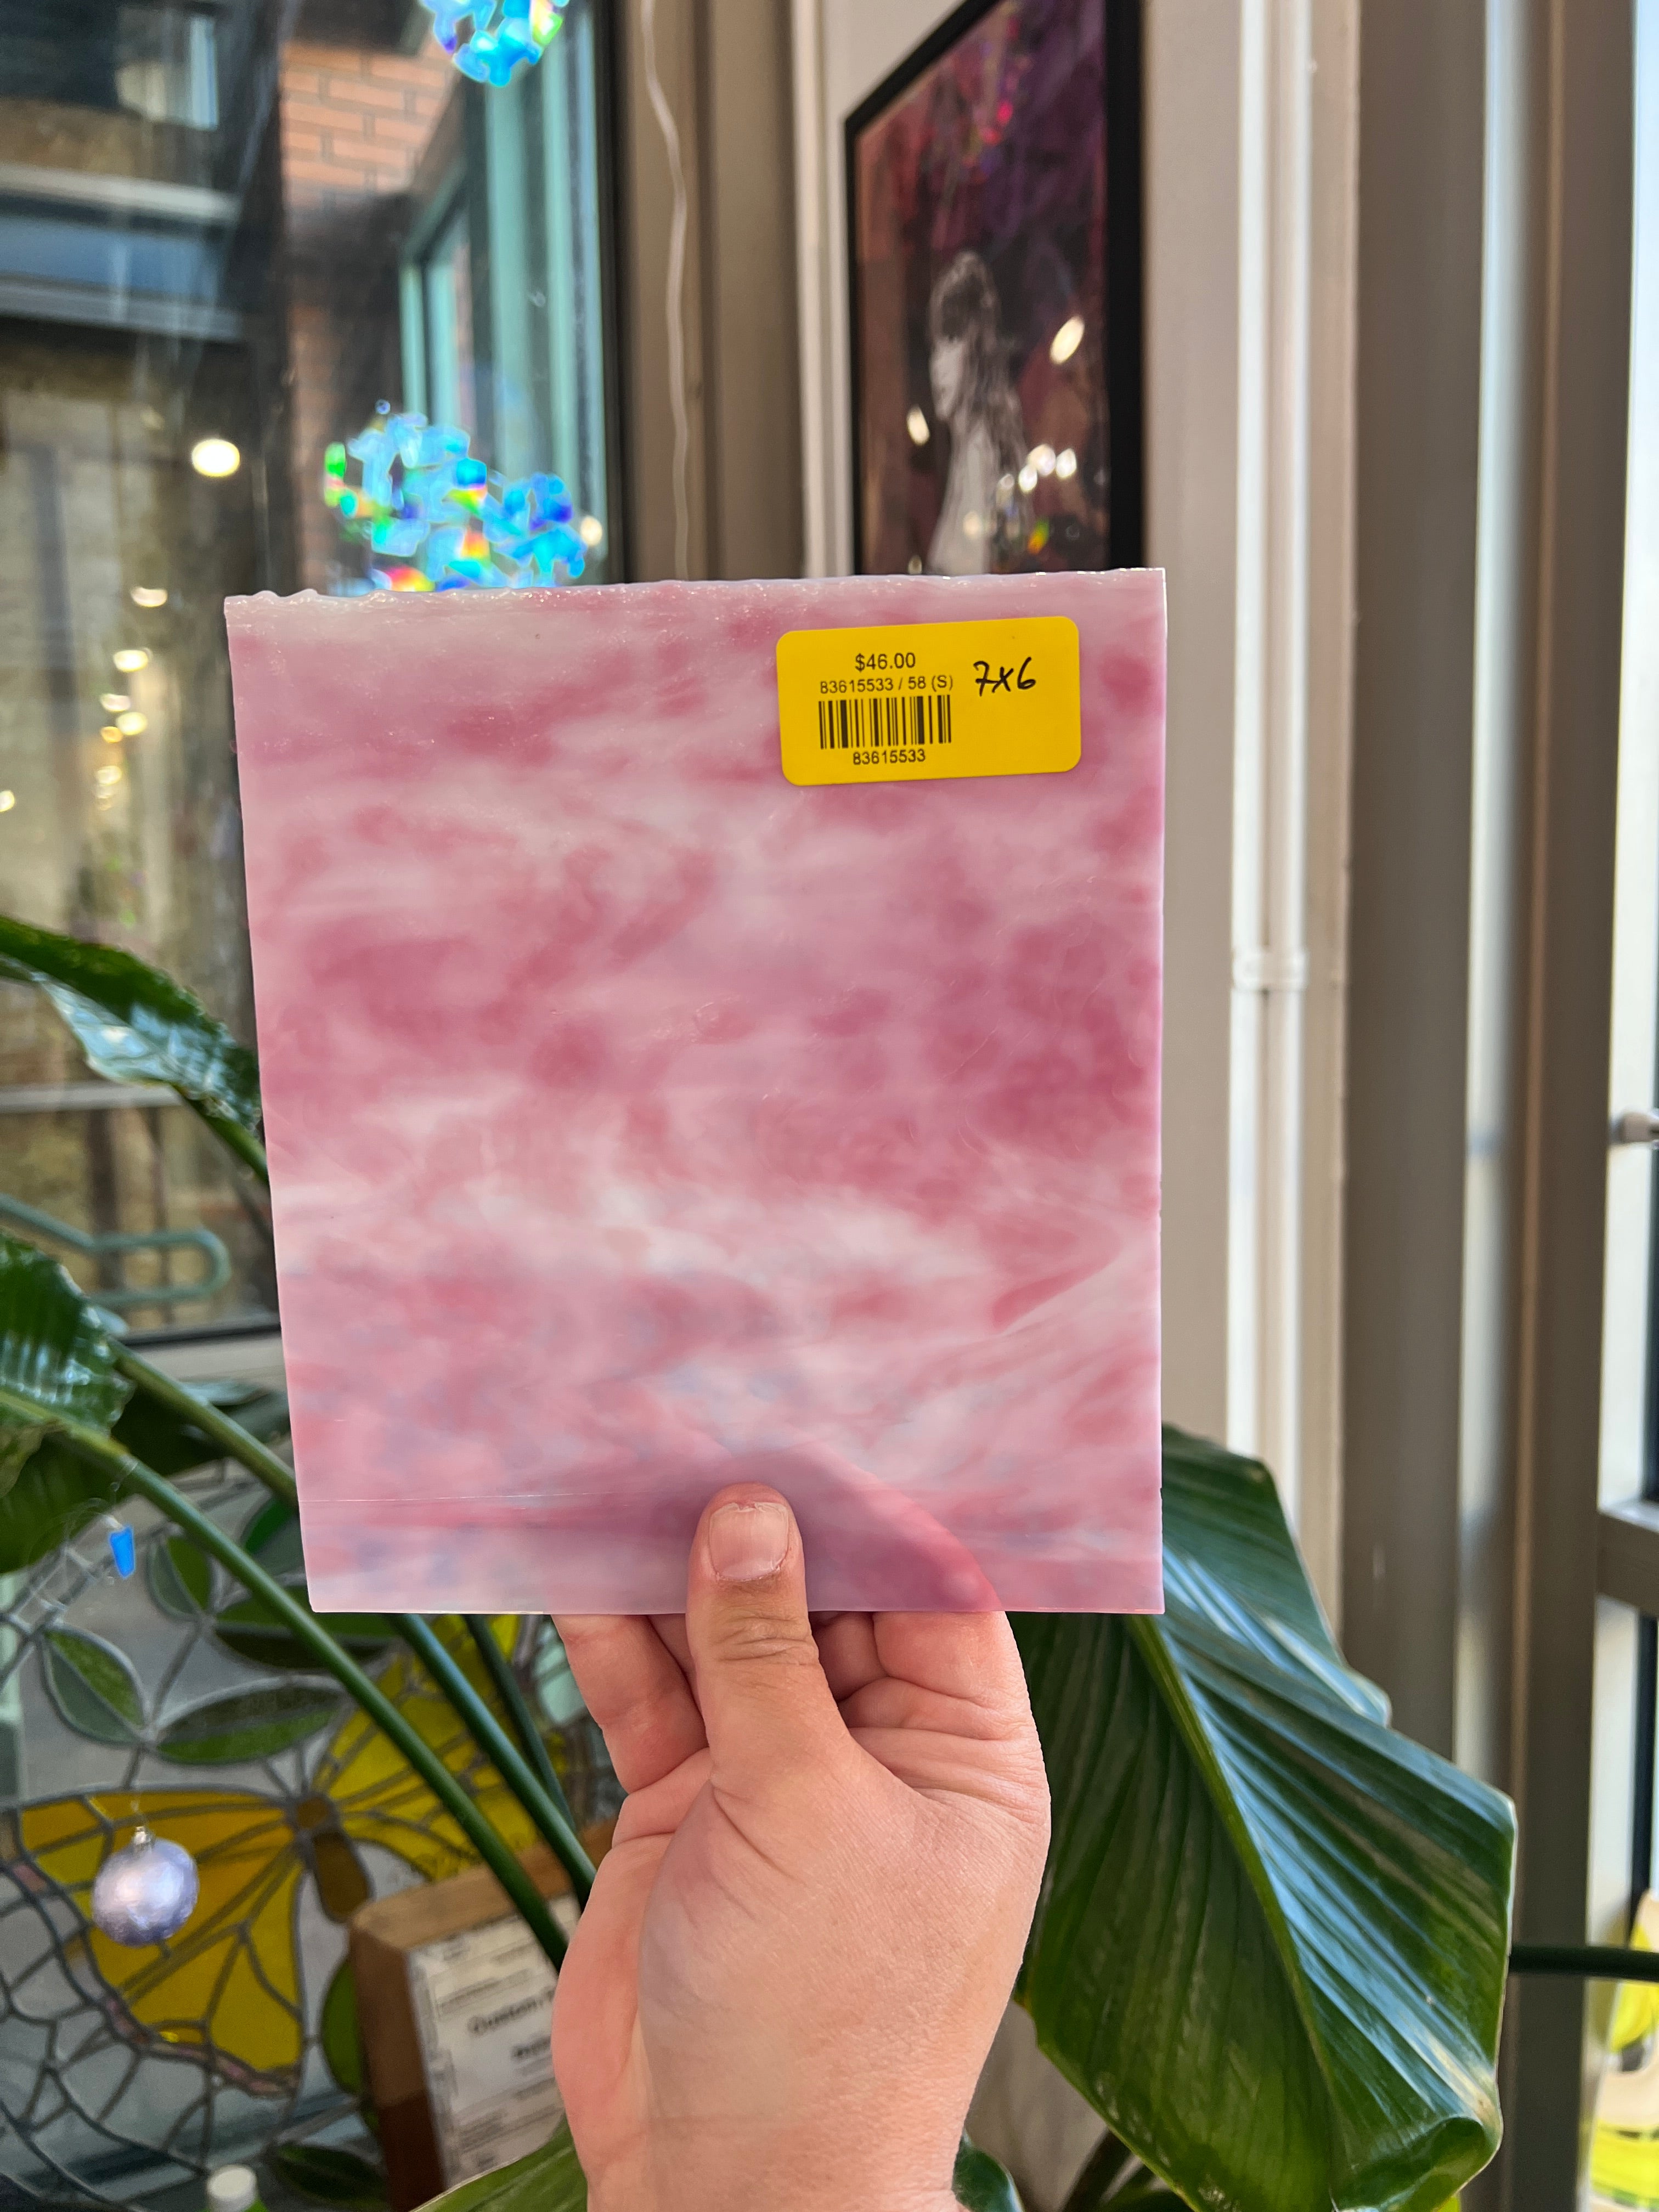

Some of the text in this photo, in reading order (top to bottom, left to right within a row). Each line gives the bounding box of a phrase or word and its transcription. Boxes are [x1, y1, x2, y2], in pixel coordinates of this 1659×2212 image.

[855, 652, 916, 673] $46.00
[820, 675, 953, 694] 83615533 / 58 (S)
[853, 749, 926, 765] 83615533
